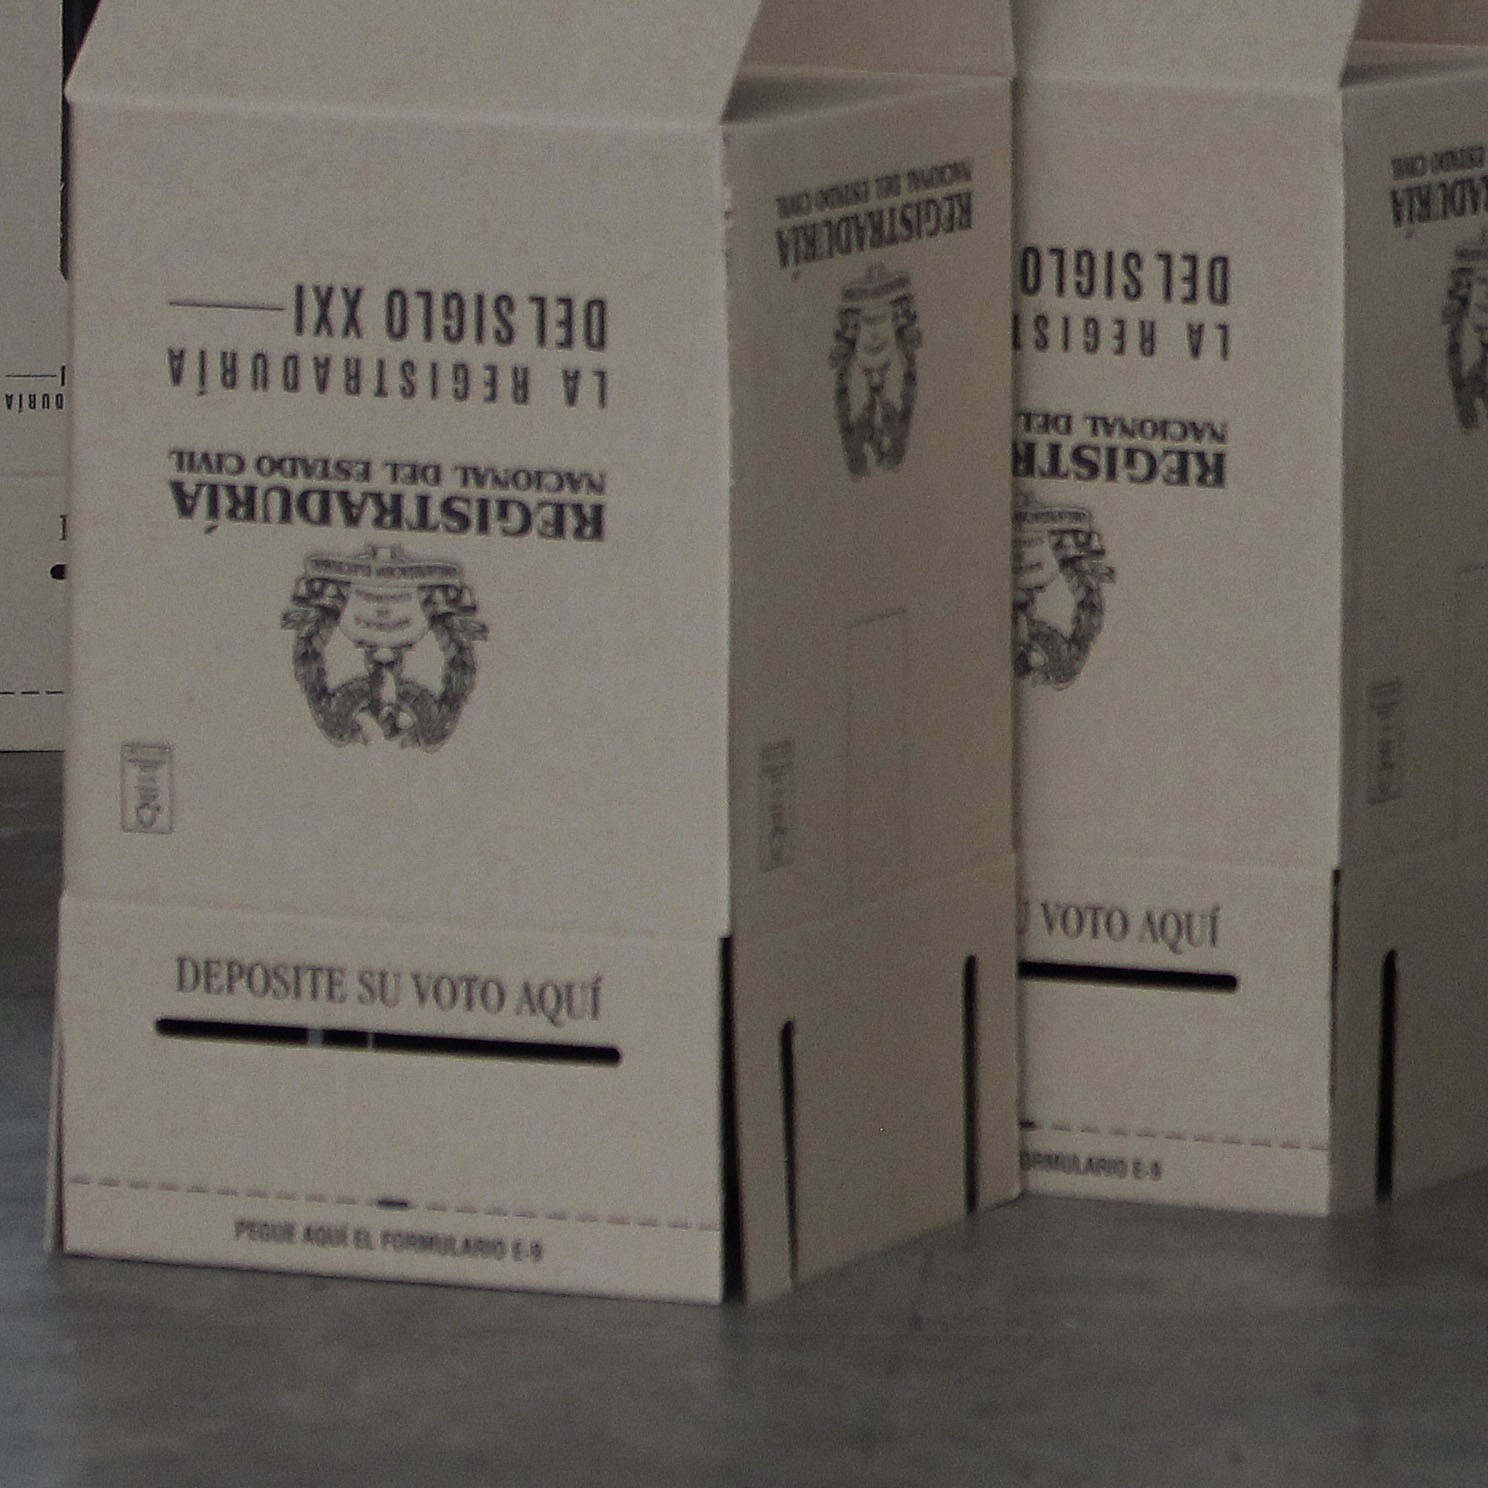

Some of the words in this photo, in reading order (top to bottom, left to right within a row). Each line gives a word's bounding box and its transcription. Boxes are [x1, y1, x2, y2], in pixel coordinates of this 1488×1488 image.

[1020, 246, 1143, 303] SIGLO
[1156, 253, 1230, 306] DEL
[293, 283, 364, 340] XXI
[385, 287, 516, 345] SIGLO
[530, 296, 607, 352] DEL
[1187, 322, 1230, 362] LA
[167, 346, 530, 407] REGISTRADURÍA
[562, 368, 608, 409] LA
[1016, 412, 1073, 436] DEL
[1085, 414, 1227, 445] NACIONAL
[169, 449, 246, 476] CIVIL
[256, 454, 372, 483] ESTADO
[384, 460, 441, 487] DEL
[460, 463, 606, 494] NACIONAL
[168, 479, 606, 542] REGISTRADURÍA
[1040, 901, 1129, 942] VOTO
[1140, 903, 1223, 955] AQUÍ
[175, 955, 346, 1004] DEPOSITE
[357, 972, 401, 1007] SU
[411, 973, 505, 1016] VOTO
[515, 973, 602, 1027] AQUÍ
